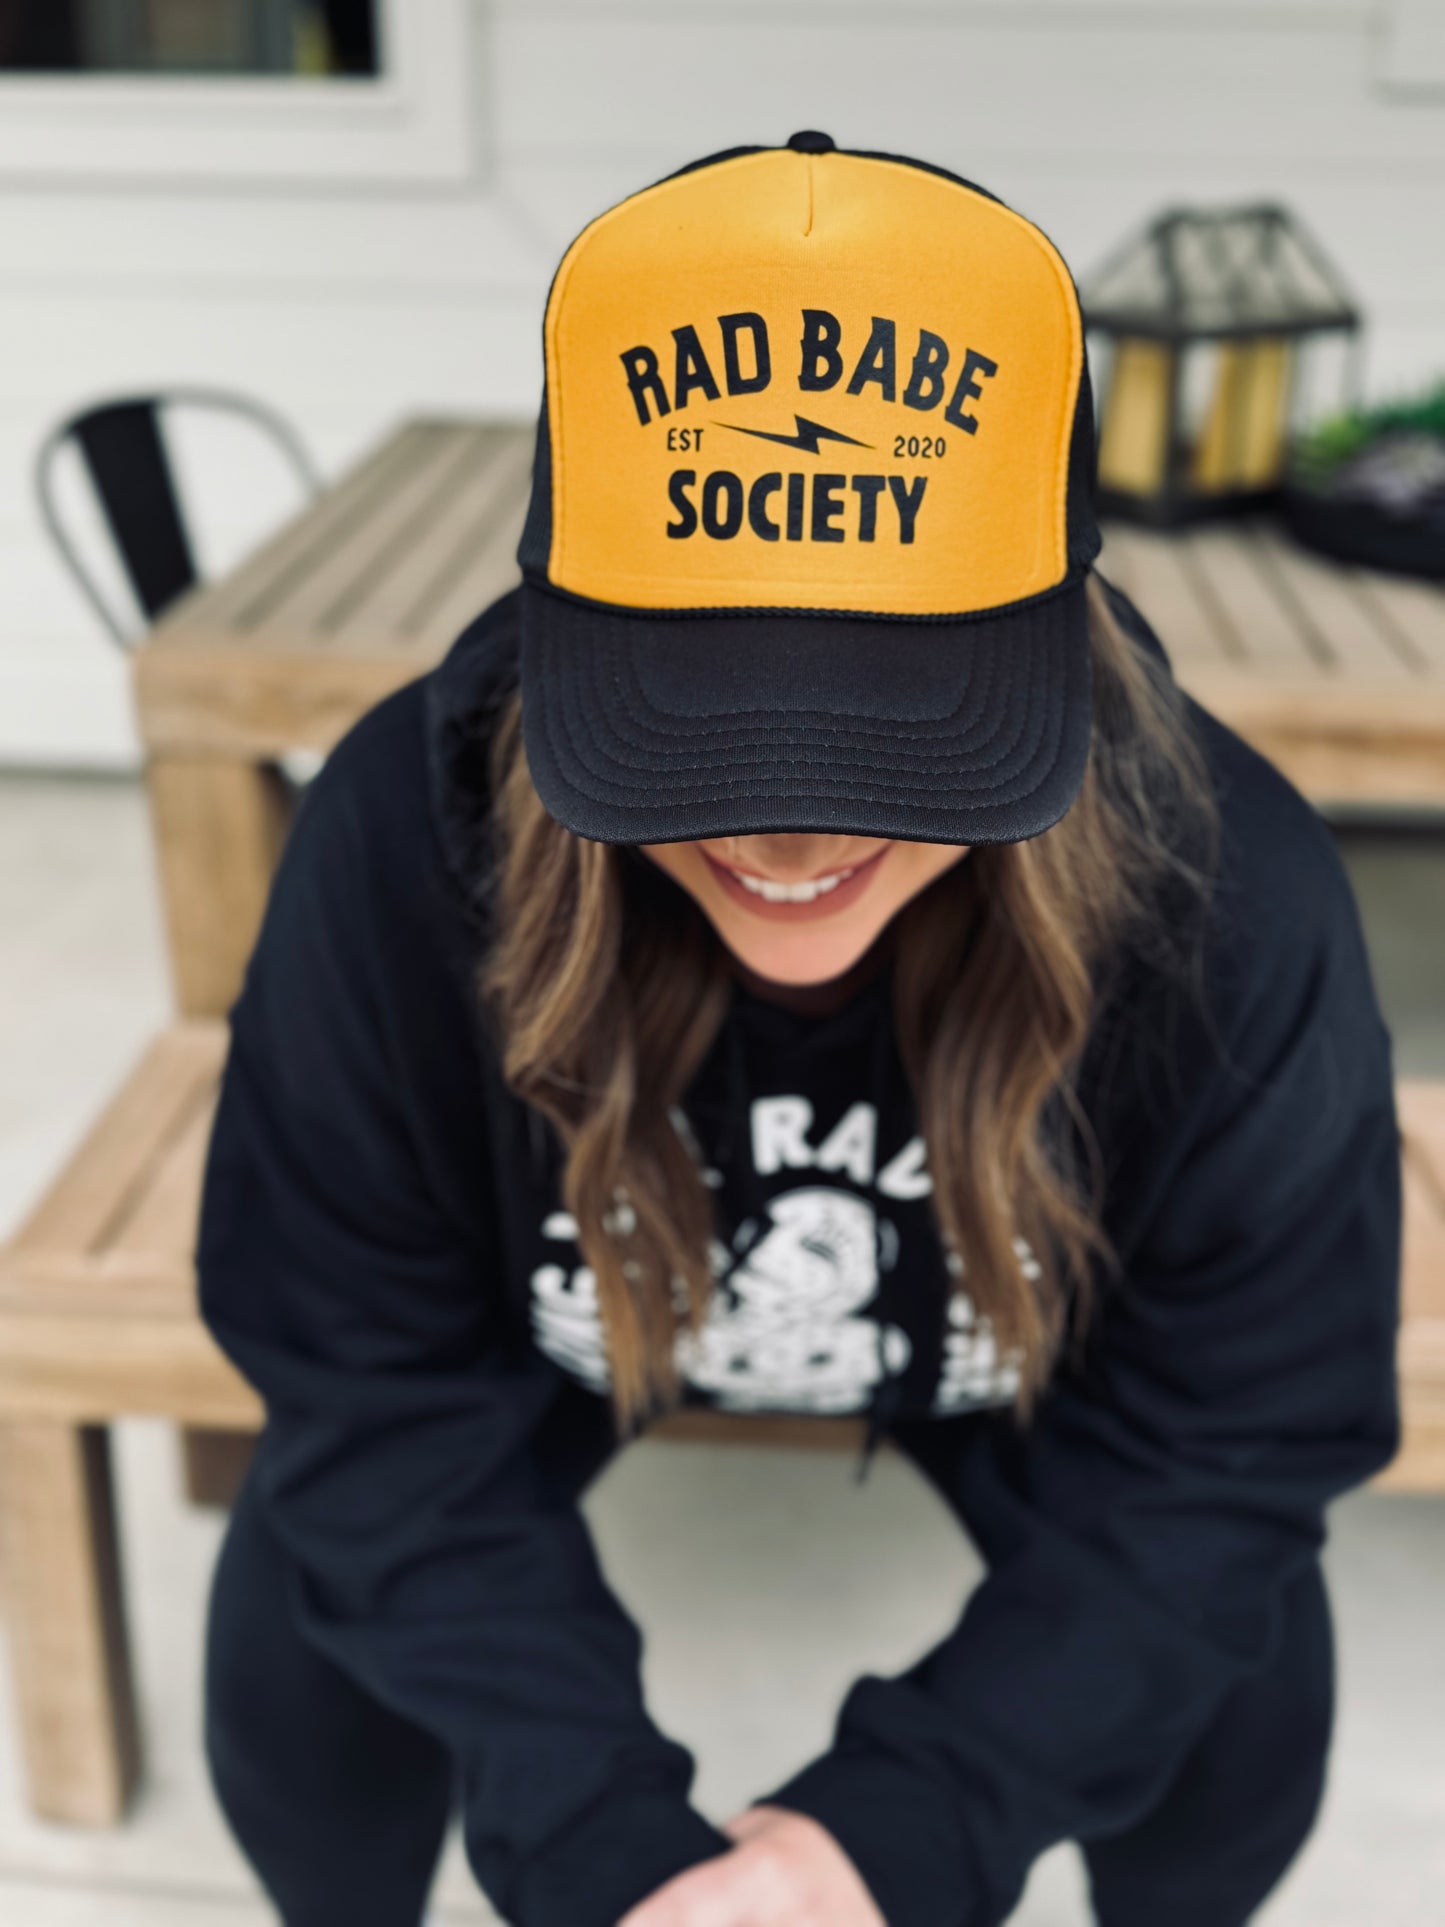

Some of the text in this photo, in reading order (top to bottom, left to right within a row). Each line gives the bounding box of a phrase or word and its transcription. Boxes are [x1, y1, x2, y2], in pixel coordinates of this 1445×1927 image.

[619, 309, 998, 436] RAD BABE
[667, 428, 946, 459] EST 2020
[666, 469, 928, 545] SOCIETY
